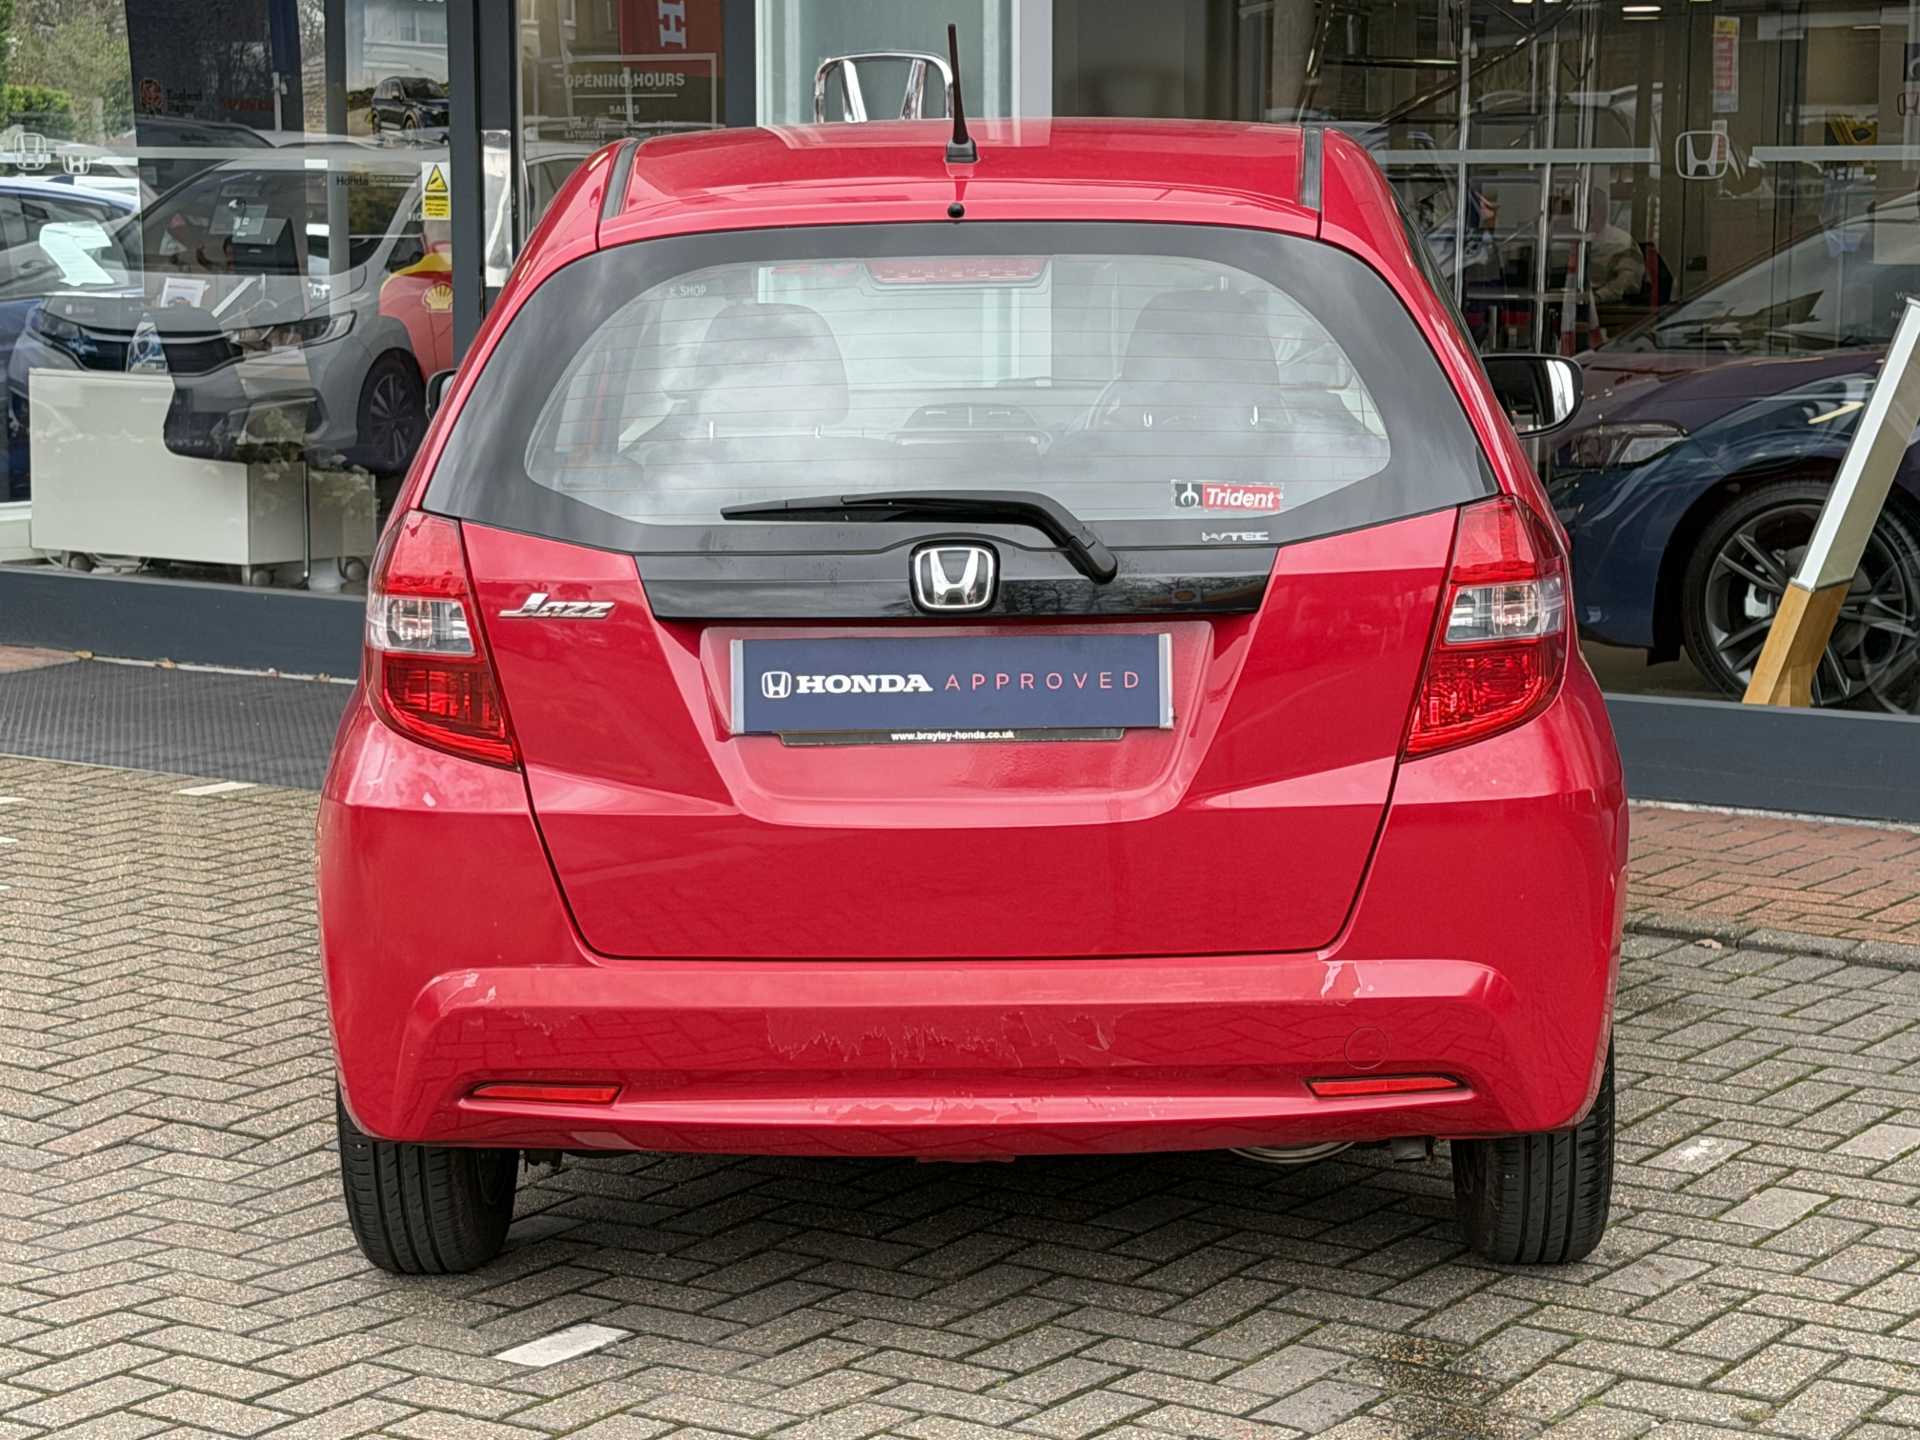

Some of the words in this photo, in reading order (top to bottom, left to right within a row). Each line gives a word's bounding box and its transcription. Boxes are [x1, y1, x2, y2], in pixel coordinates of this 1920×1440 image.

[564, 73, 629, 88] OPENING
[634, 73, 685, 87] HOURS
[609, 104, 640, 114] SALS
[1206, 488, 1275, 508] Trident
[498, 592, 615, 619] Jazz
[796, 674, 934, 694] HONDA
[944, 671, 1140, 691] APPROVED
[890, 730, 1016, 742] www.brayley-honda.co.uk
